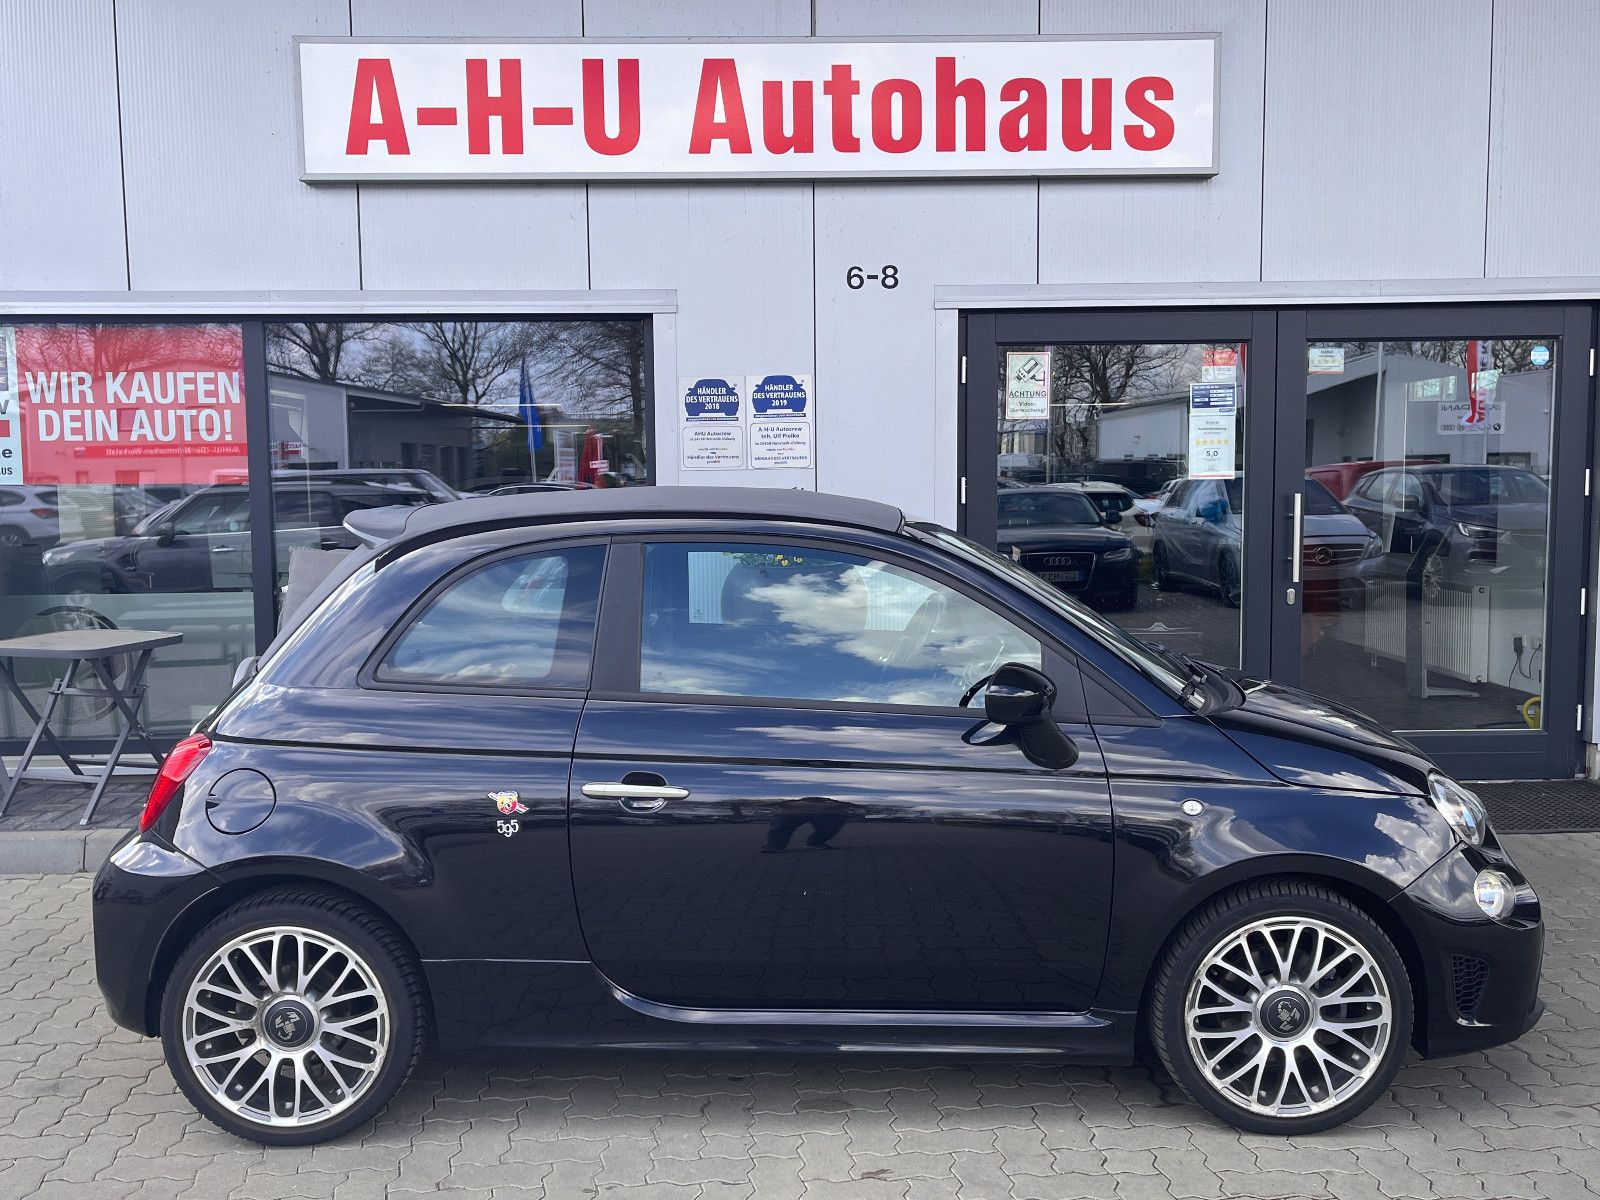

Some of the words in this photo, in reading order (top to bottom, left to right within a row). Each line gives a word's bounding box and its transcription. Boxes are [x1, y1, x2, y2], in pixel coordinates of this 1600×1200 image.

[345, 58, 640, 156] A-H-U
[689, 57, 1174, 155] Autohaus
[846, 264, 899, 290] 6-8
[25, 371, 94, 404] WIR
[105, 371, 241, 404] KAUFEN
[697, 386, 727, 395] HÄNDLER
[764, 383, 794, 391] HÄNDLER
[766, 391, 806, 399] VERTRAUENS
[1009, 390, 1047, 398] ACHTUNG
[685, 395, 698, 403] DES
[698, 395, 739, 403] VERTRAUENS
[771, 399, 788, 407] 2019
[37, 409, 119, 442] DEIN
[130, 409, 233, 442] AUTO!
[1205, 450, 1219, 458] 5,0
[496, 819, 519, 838] 595
